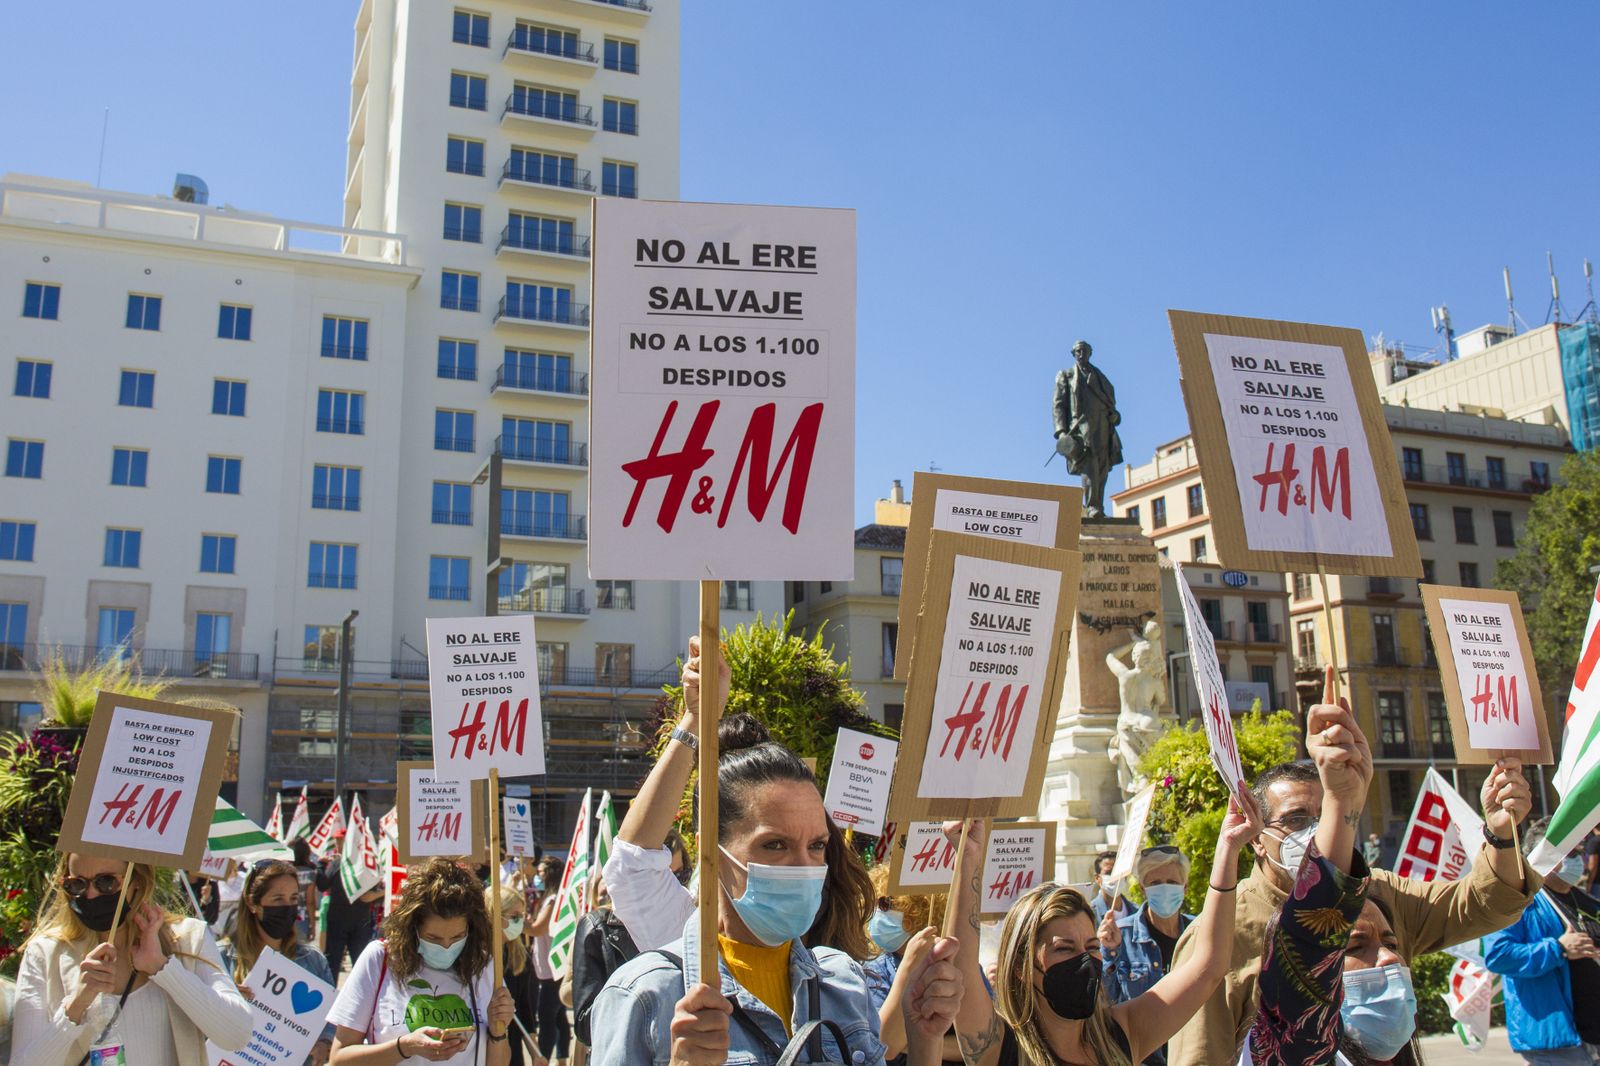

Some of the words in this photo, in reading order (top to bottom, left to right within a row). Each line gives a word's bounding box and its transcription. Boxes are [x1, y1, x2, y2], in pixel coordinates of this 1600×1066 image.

[635, 239, 685, 263] NO
[697, 241, 740, 266] AL
[752, 244, 817, 269] ERE
[647, 286, 803, 315] SALVAJE
[629, 332, 666, 350] NO
[674, 334, 691, 352] A
[700, 335, 747, 353] LOS
[756, 337, 819, 355] 1.100
[1231, 356, 1257, 370] NO
[1263, 358, 1286, 373] AL
[1290, 361, 1325, 376] ERE
[662, 368, 787, 388] DESPIDOS
[1244, 380, 1324, 400] SALVAJE
[1240, 404, 1259, 415] NO
[1263, 406, 1274, 416] A
[1276, 407, 1301, 419] LOS
[1305, 410, 1338, 422] 1.100
[1262, 424, 1326, 439] DESPIDOS
[621, 400, 824, 535] H&M
[1252, 442, 1352, 520] H&M
[952, 506, 983, 516] BASTA
[985, 509, 998, 518] DE
[1000, 511, 1038, 522] EMPLEO
[964, 522, 990, 532] LOW
[992, 525, 1023, 536] COST
[1103, 566, 1130, 575] LARIOS
[1224, 572, 1246, 585] HOTEL
[969, 582, 990, 599] NO
[994, 586, 1011, 601] AL
[1015, 589, 1041, 605] ERE
[970, 612, 1032, 633] SALVAJE
[1454, 614, 1468, 623] NO
[1470, 615, 1482, 625] AL
[1483, 616, 1502, 626] ERE
[446, 634, 466, 645] NO
[471, 633, 489, 644] AL
[494, 632, 521, 643] ERE
[1462, 632, 1502, 643] SALVAJE
[959, 639, 974, 650] NO
[976, 641, 984, 652] A
[987, 641, 1006, 655] LOS
[1009, 644, 1033, 657] 1.100
[1479, 649, 1492, 657] LOS
[453, 652, 517, 665] SALVAJE
[1472, 662, 1505, 670] DESPIDOS
[447, 674, 462, 683] NO
[465, 674, 472, 682] A
[475, 672, 495, 681] LOS
[498, 671, 525, 680] 1.100
[969, 661, 1018, 676] DESPIDOS
[462, 686, 513, 696] DESPIDOS
[1470, 674, 1519, 726] H&M
[125, 720, 150, 729] BASTA
[164, 726, 195, 736] EMPLEO
[448, 698, 529, 760] H&M
[940, 681, 1029, 762] H&M
[133, 733, 154, 742] LOW
[156, 736, 181, 746] COST
[158, 750, 176, 758] LOS
[128, 756, 174, 770] DESPIDOS
[855, 764, 879, 775] DESPIDOS
[112, 766, 185, 783] INJUSTIFICADOS
[849, 772, 873, 784] BBVA
[99, 782, 182, 835] H&M
[417, 812, 462, 842] H&M
[988, 870, 1034, 900] H&M
[262, 969, 287, 996] YO
[391, 1008, 414, 1026] LA
[265, 1022, 276, 1033] SI
[283, 1017, 310, 1038] VIVOS!
[252, 1030, 284, 1052] equeño
[286, 1049, 293, 1058] y
